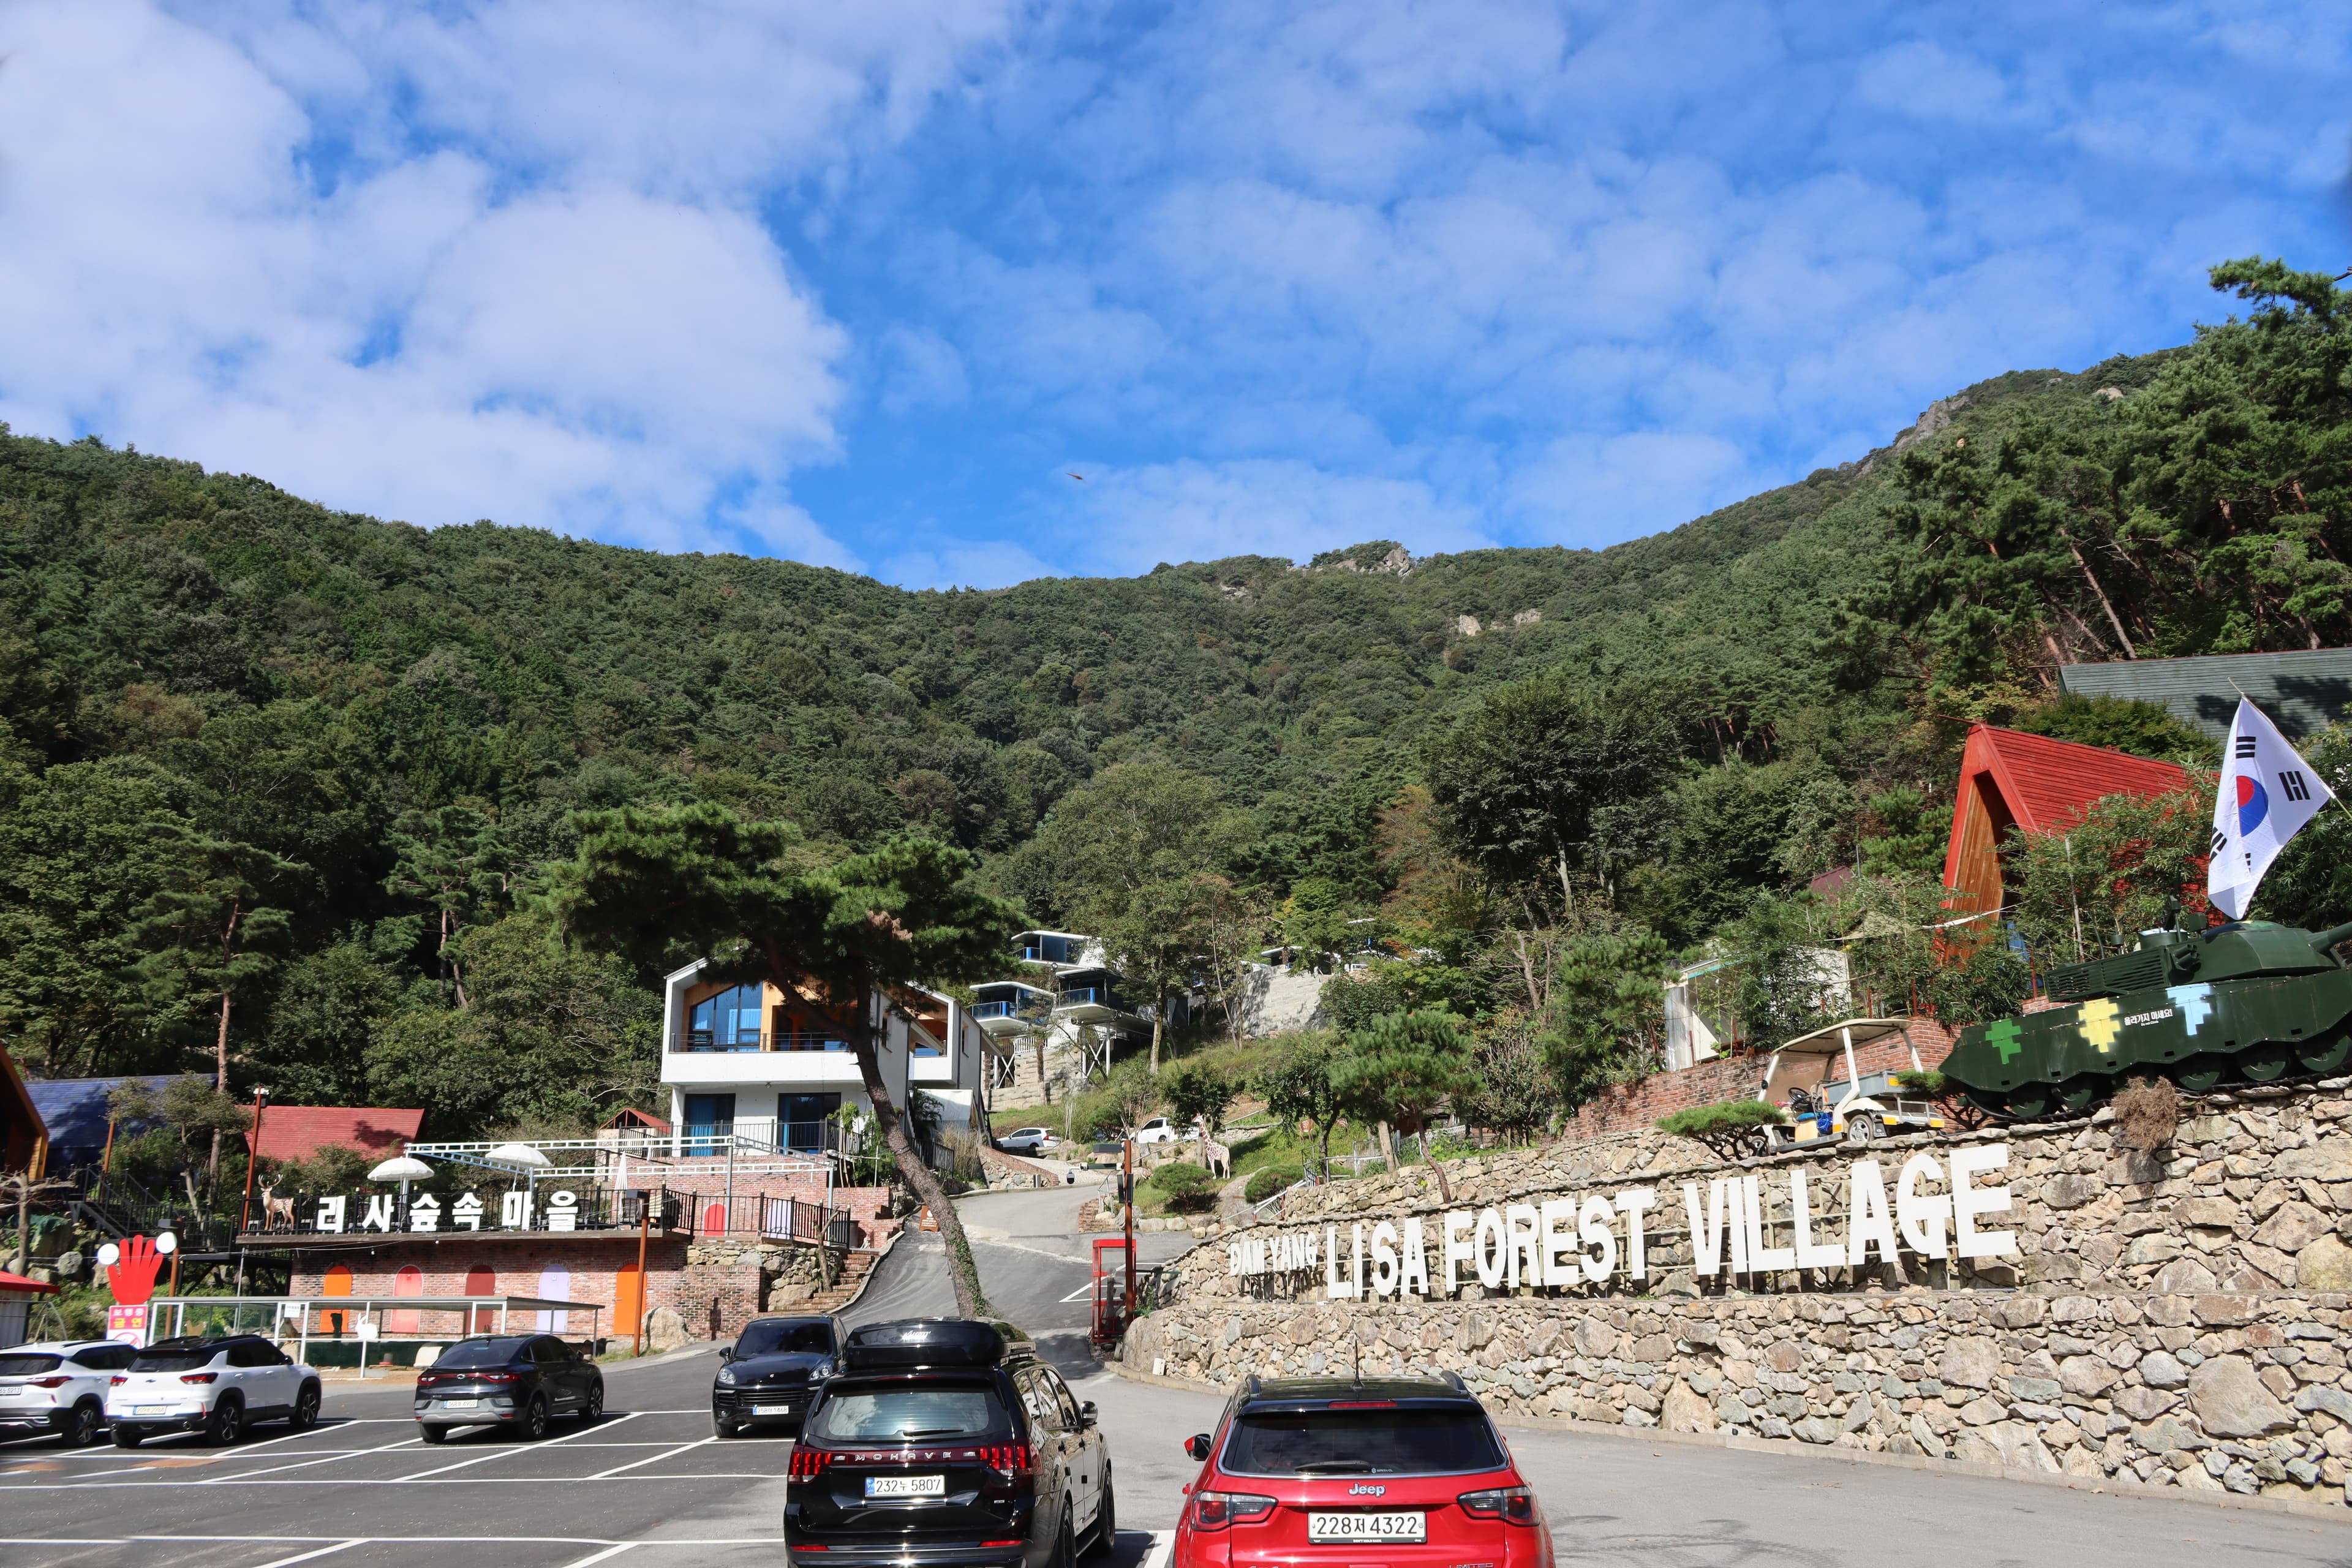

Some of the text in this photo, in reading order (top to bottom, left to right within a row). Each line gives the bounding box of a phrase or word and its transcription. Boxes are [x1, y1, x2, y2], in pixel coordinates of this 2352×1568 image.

[2124, 1008, 2173, 1026] 올라가지 마세요!
[1230, 1144, 2017, 1298] DAM YANG LISA FOREST VILLAGE
[854, 1451, 952, 1461] MOHAVE
[876, 1479, 941, 1492] 232누 5807
[1348, 1482, 1386, 1498] Jeep
[1317, 1517, 1417, 1534] 228저 4322
